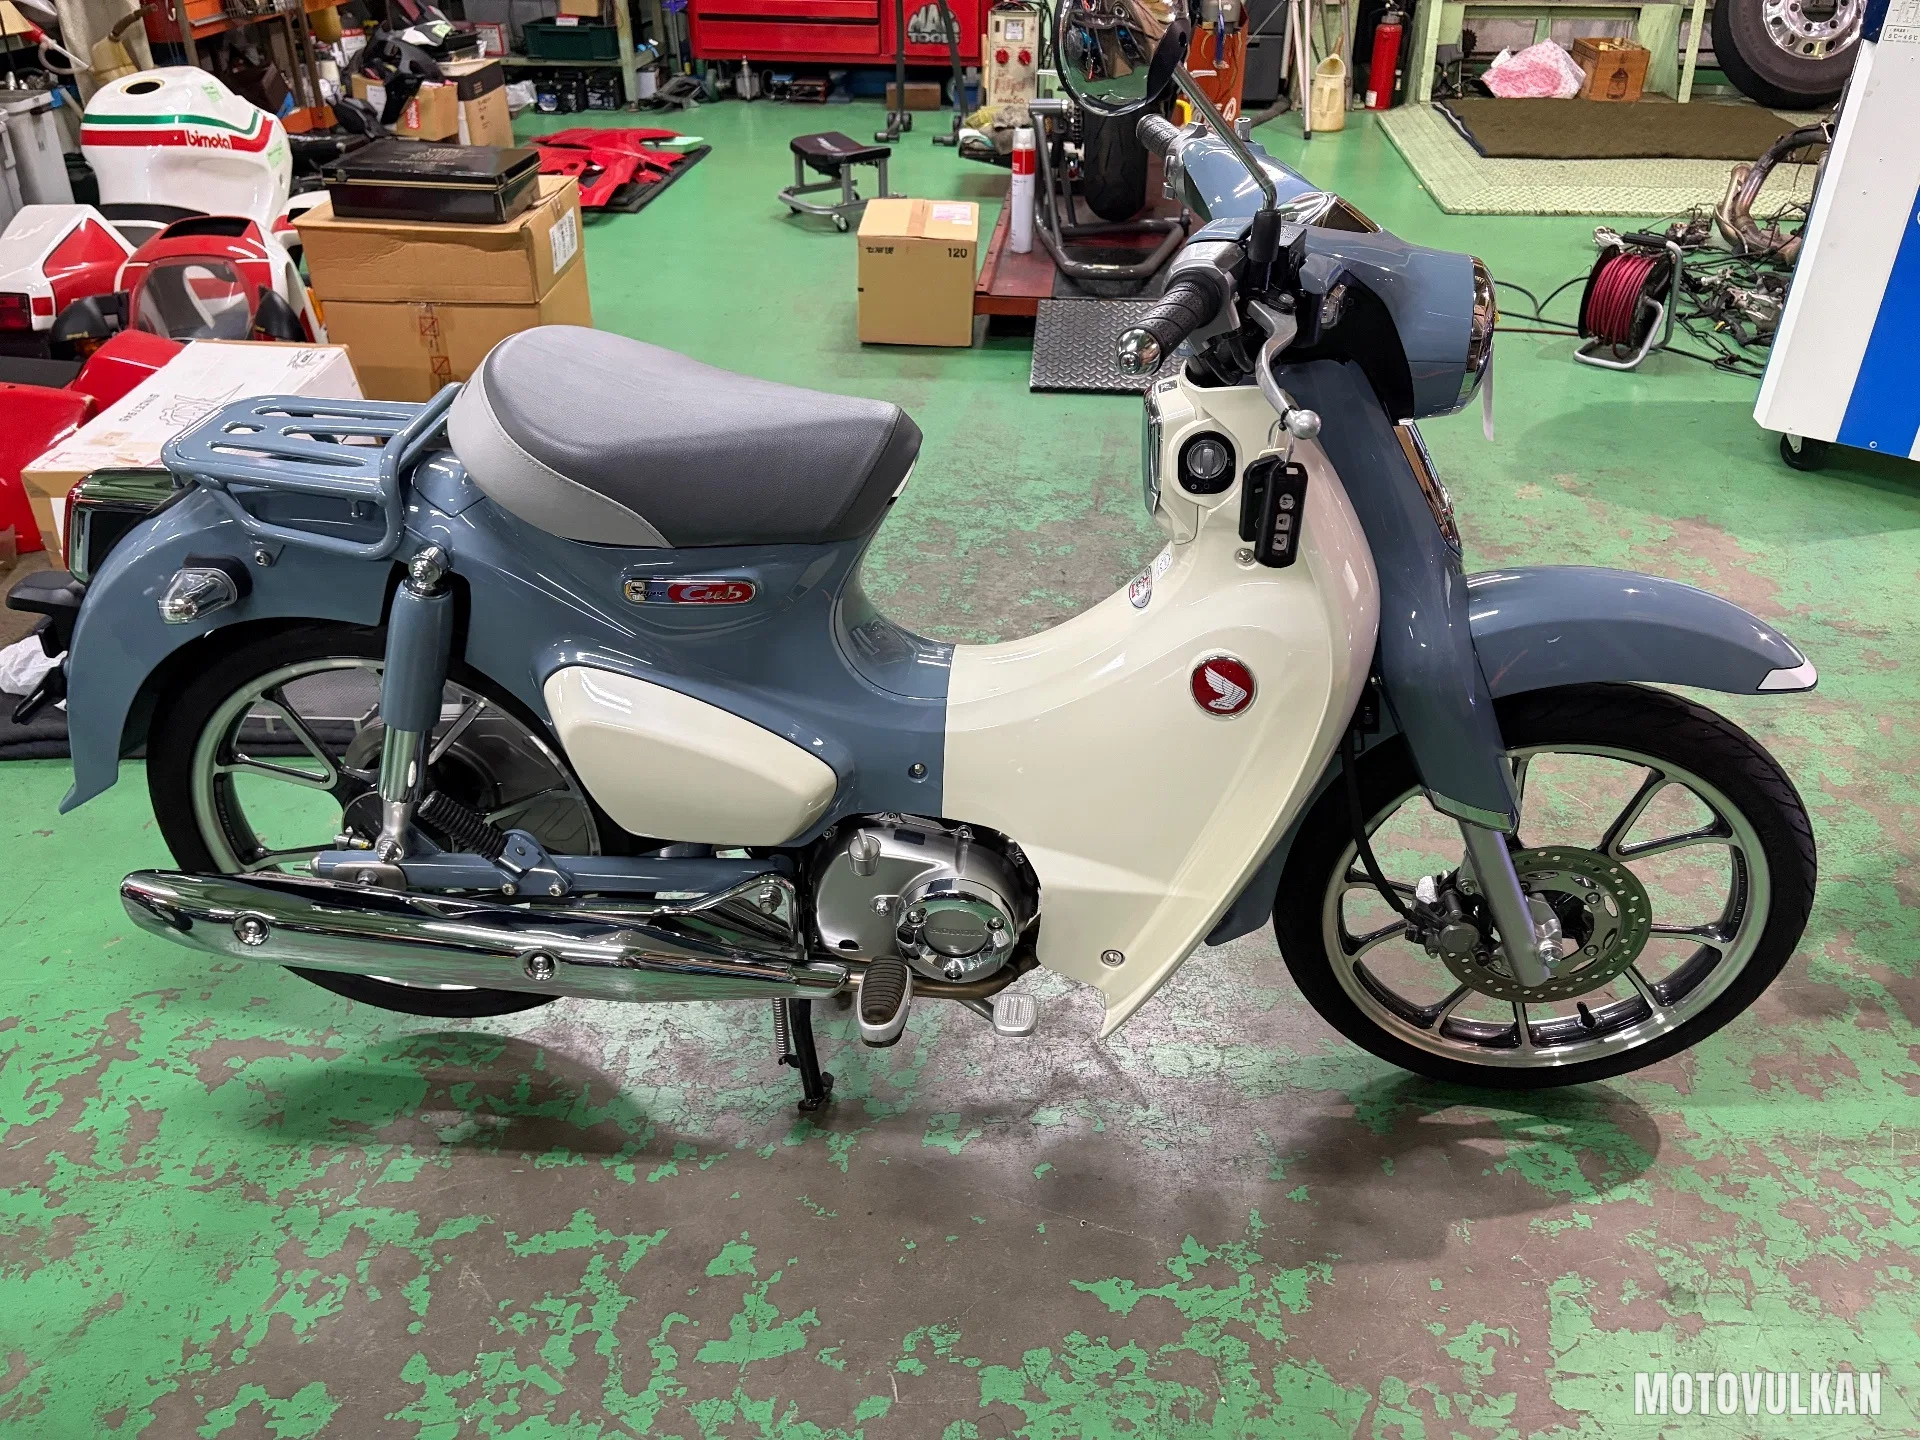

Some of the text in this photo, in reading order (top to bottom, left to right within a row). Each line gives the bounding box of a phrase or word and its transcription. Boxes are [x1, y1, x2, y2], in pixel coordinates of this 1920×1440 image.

[186, 129, 231, 150] bimota
[947, 247, 968, 259] 120
[630, 585, 743, 601] Super Cub
